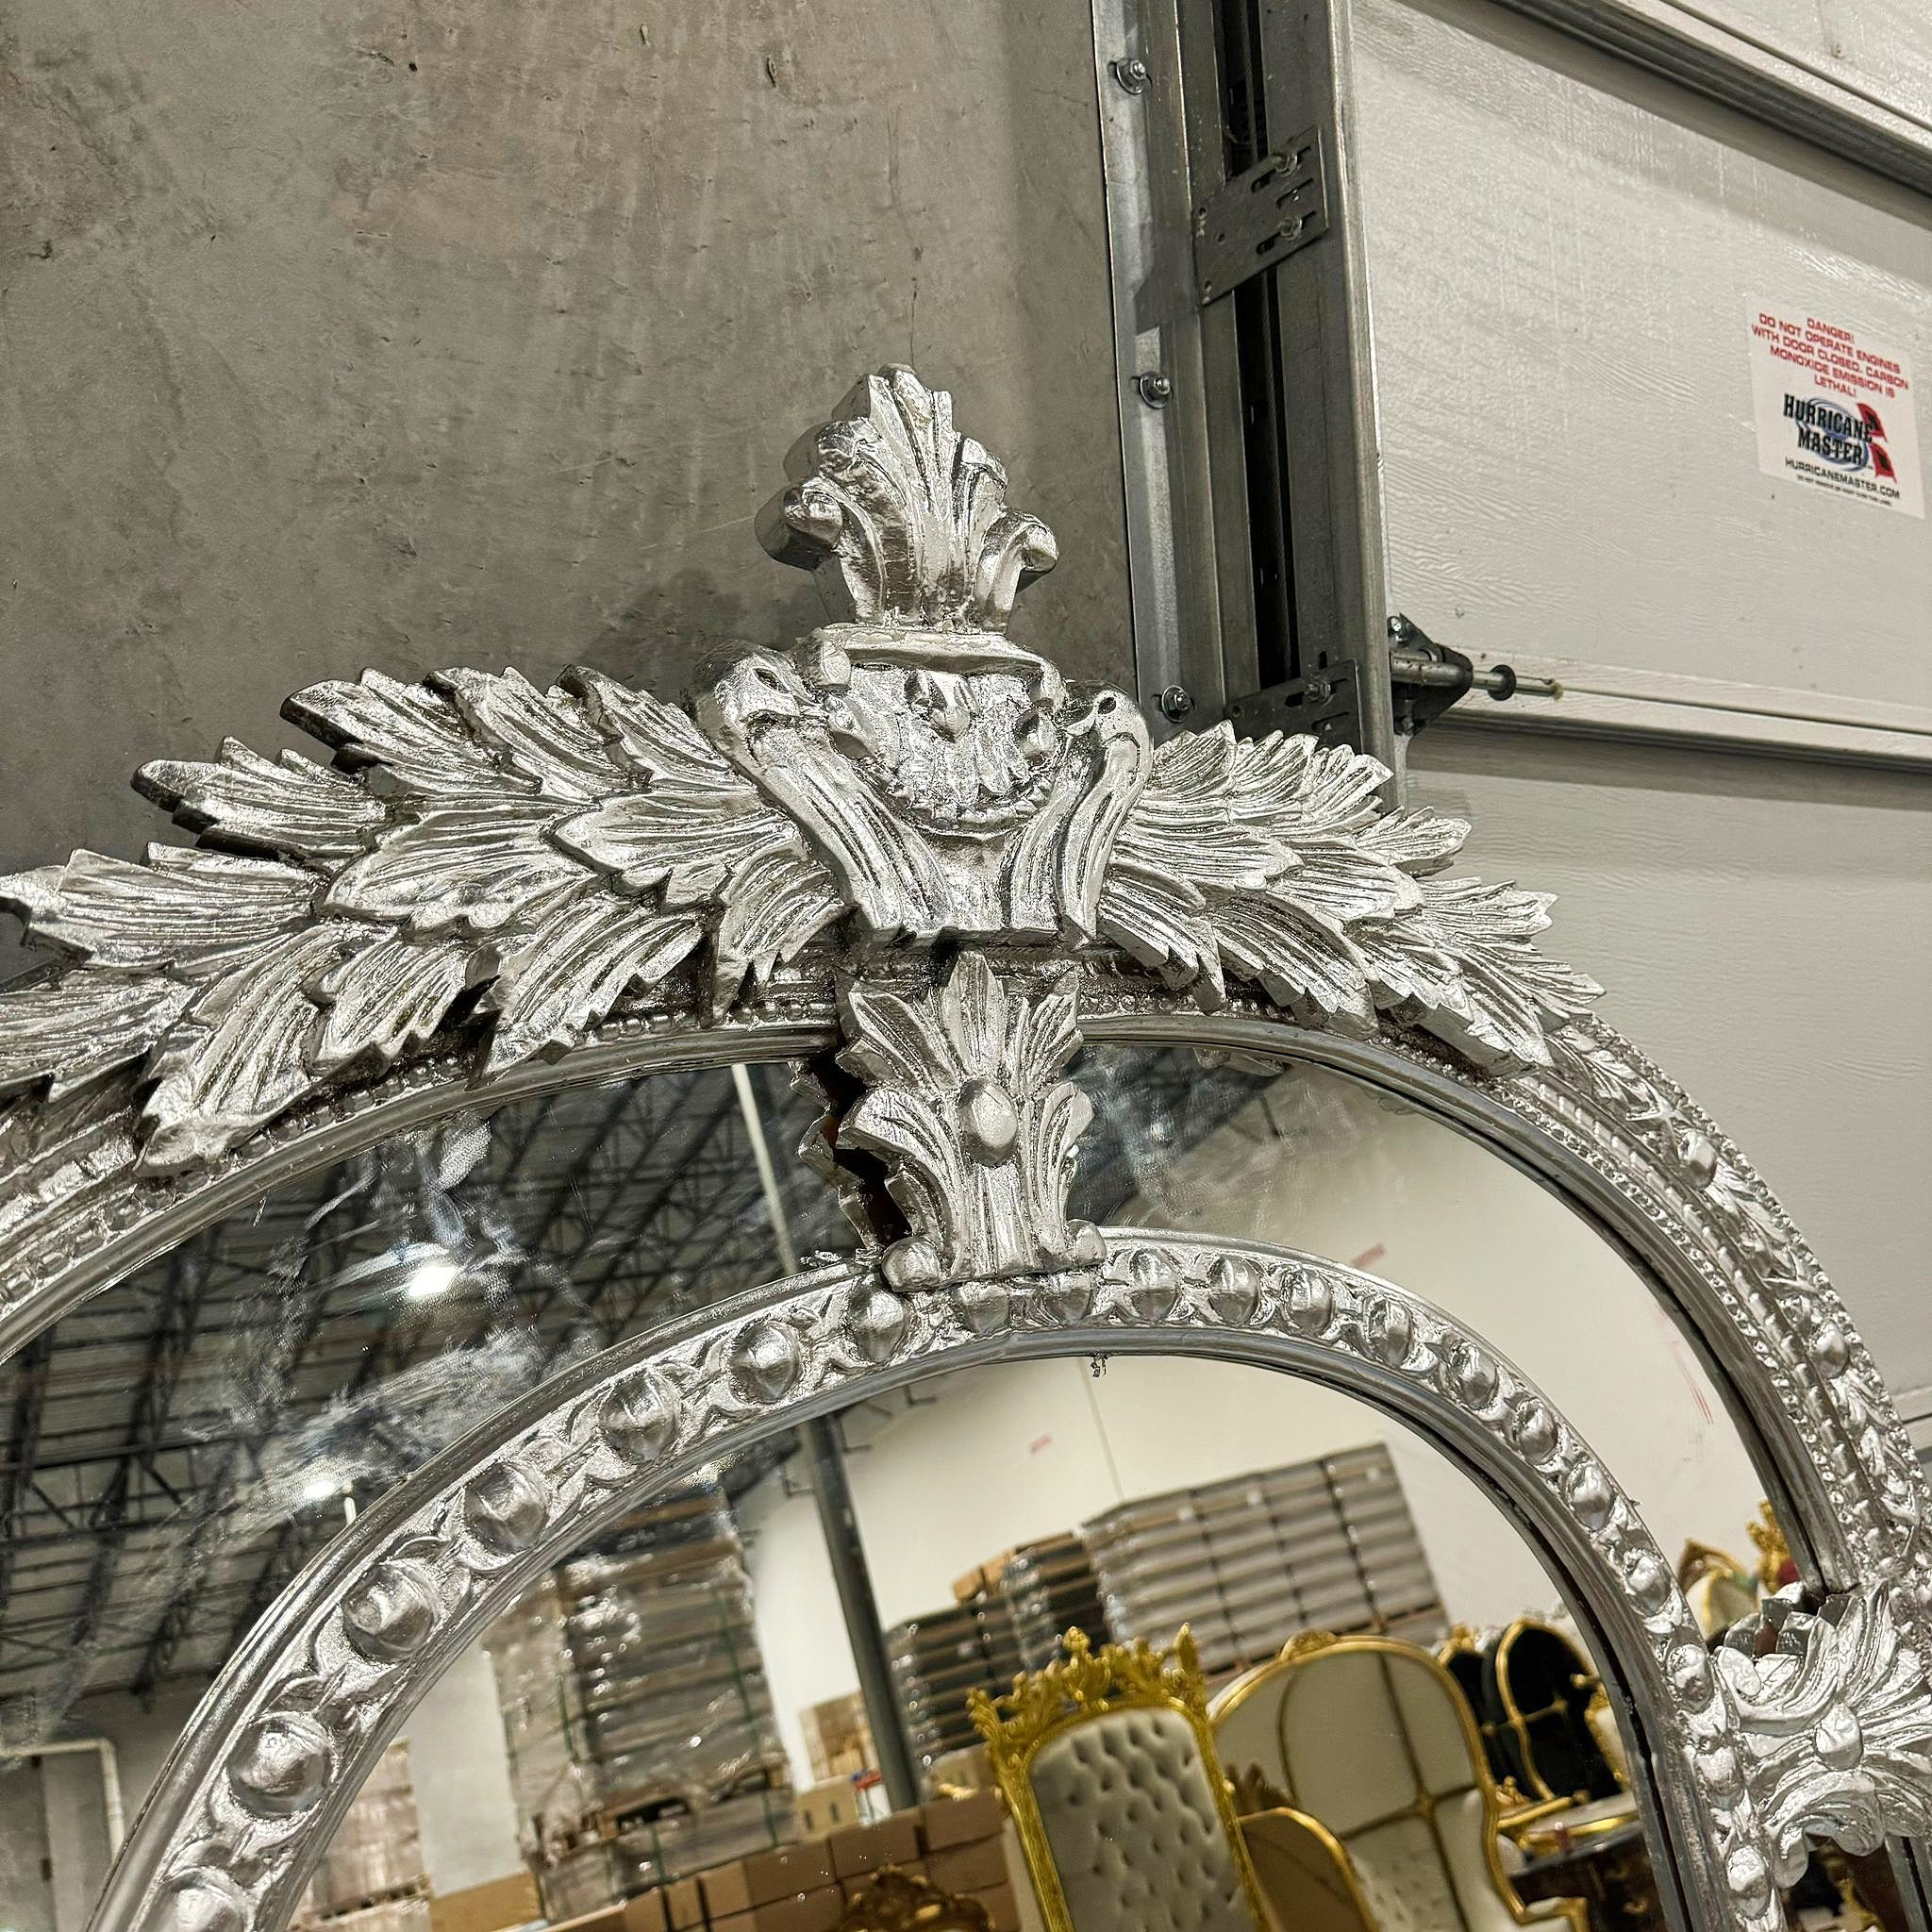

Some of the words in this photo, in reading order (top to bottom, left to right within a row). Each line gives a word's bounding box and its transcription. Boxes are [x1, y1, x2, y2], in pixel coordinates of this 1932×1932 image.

[1759, 313, 1775, 327] DO
[1779, 322, 1801, 336] NOT
[1806, 331, 1854, 357] OPERATE
[1857, 350, 1900, 374] ENGINES
[1807, 318, 1854, 342] DANGER!
[1752, 325, 1779, 342] WITH
[1783, 337, 1814, 356] DOOR
[1866, 367, 1908, 389] CARBON
[1770, 346, 1829, 375] MONOXIDE
[1833, 368, 1882, 393] EMISSION
[1885, 386, 1895, 398] IS
[1814, 375, 1857, 397] LETHAL!
[1783, 393, 1873, 443] HURRICANE
[1798, 428, 1863, 465] MASTER
[1785, 458, 1900, 498] HURRICANEMASTER.COM
